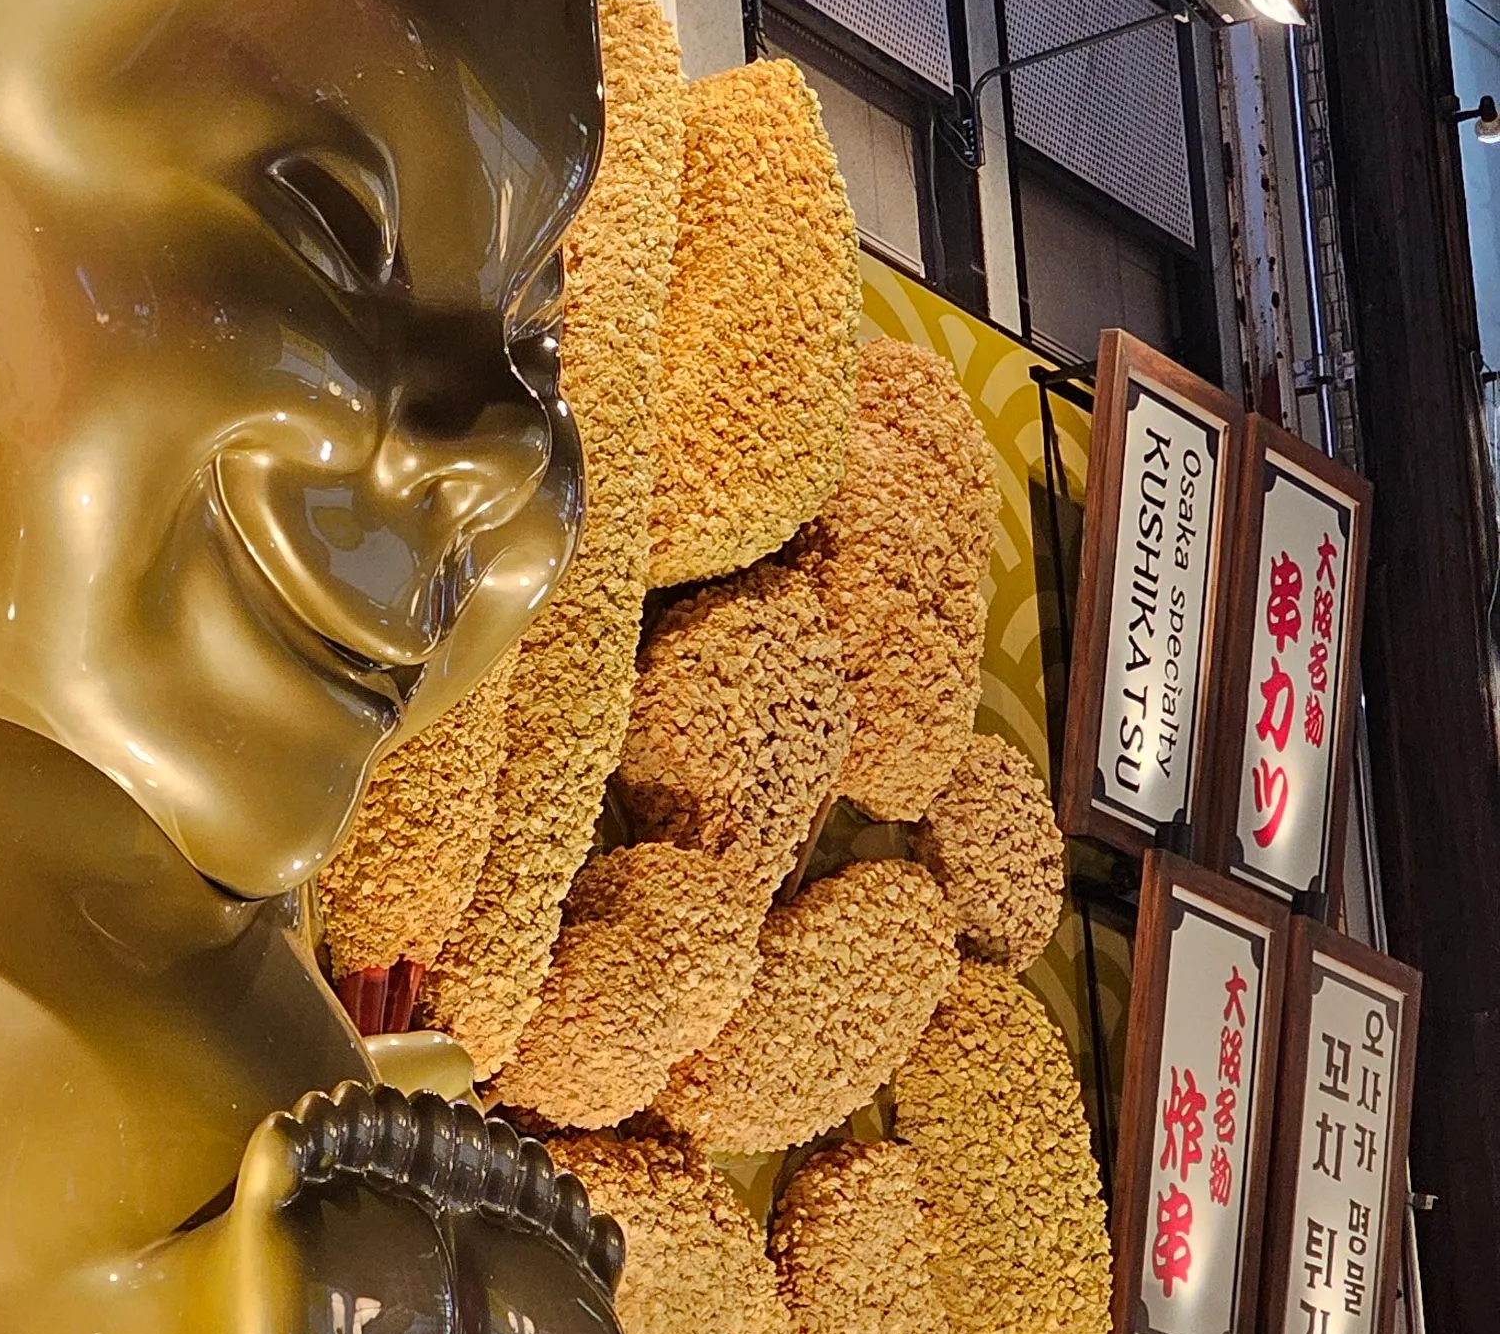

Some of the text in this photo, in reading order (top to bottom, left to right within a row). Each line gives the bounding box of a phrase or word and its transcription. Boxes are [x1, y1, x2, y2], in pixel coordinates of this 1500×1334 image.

[1115, 426, 1173, 794] KUSHIKATSU
[1156, 448, 1203, 779] Osaka specialty
[1251, 550, 1303, 849] 串カツ
[1303, 532, 1339, 749] 大阪名物
[1151, 1065, 1208, 1299] 炸串
[1209, 965, 1249, 1208] 大阪名物
[1343, 1009, 1385, 1317] 오사카 명물
